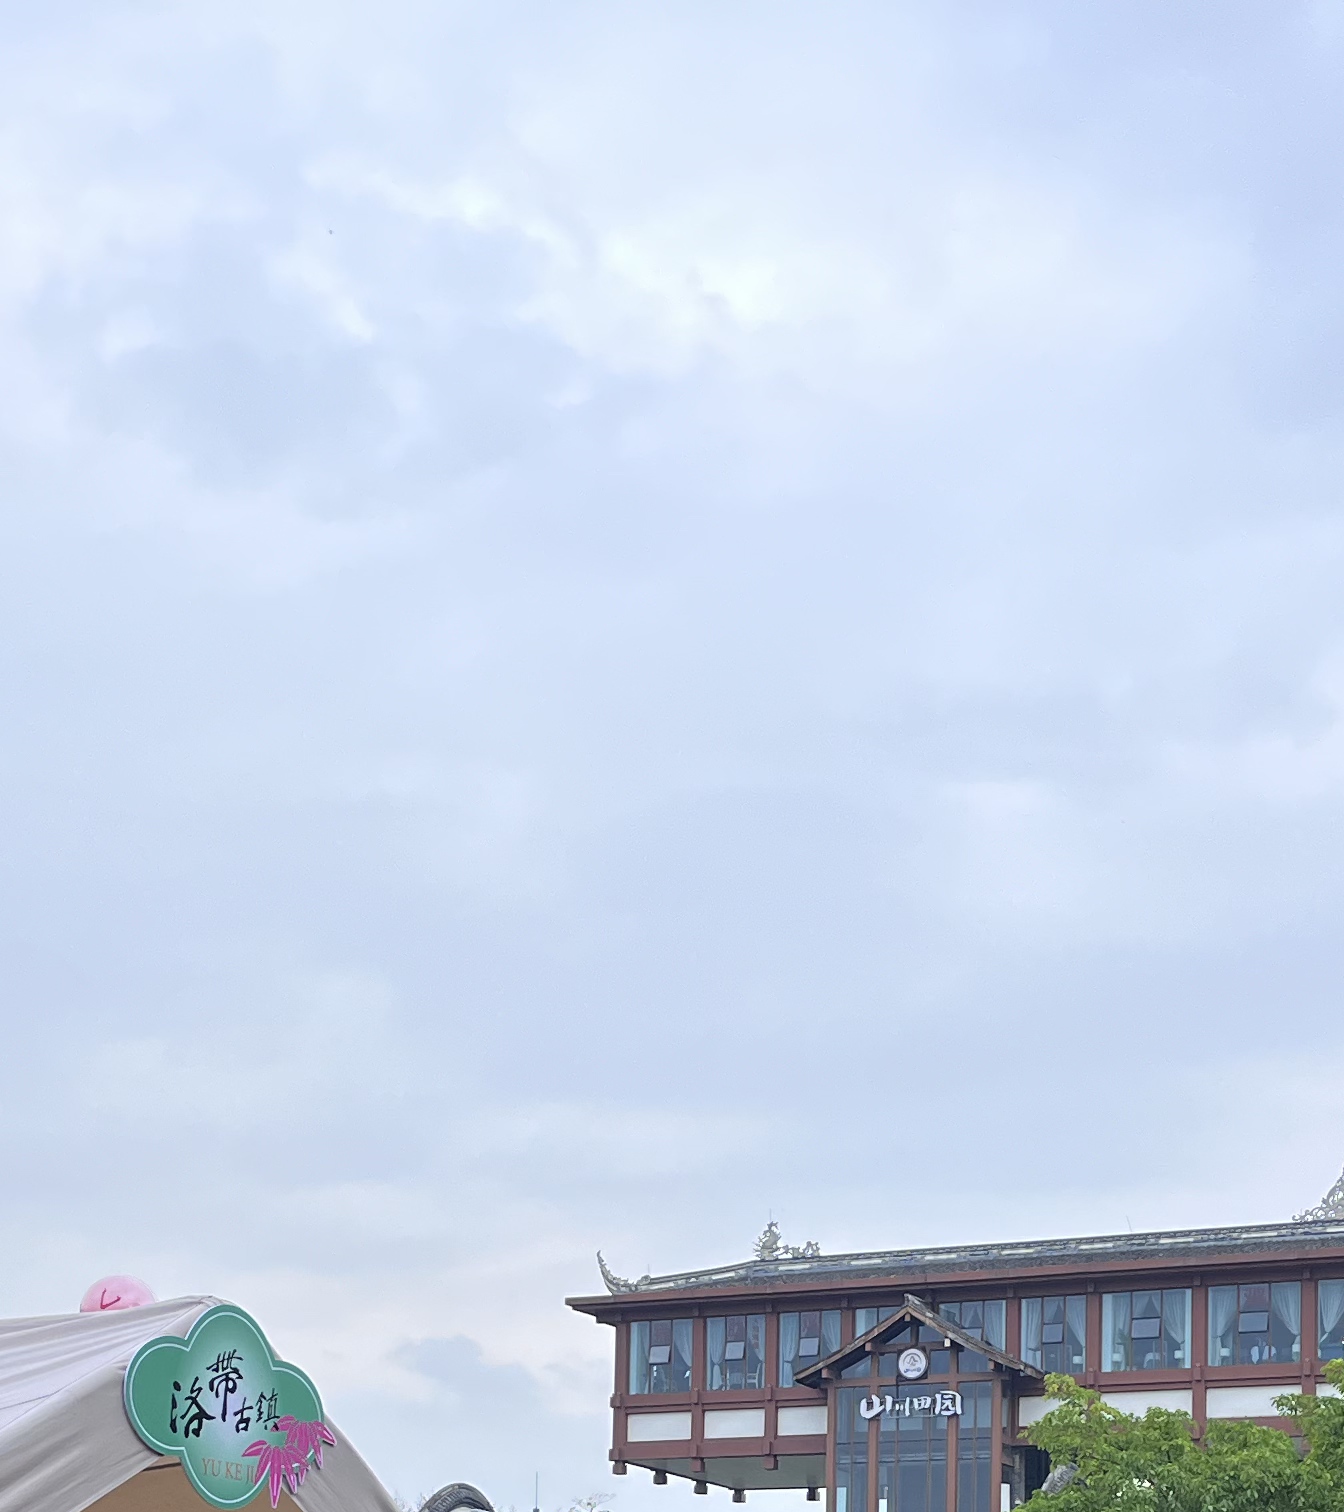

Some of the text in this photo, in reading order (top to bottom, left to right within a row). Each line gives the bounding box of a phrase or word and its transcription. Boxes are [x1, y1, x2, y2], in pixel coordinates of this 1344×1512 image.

[859, 1390, 963, 1419] 山川田园
[202, 1458, 221, 1477] YU
[224, 1463, 243, 1482] KE
